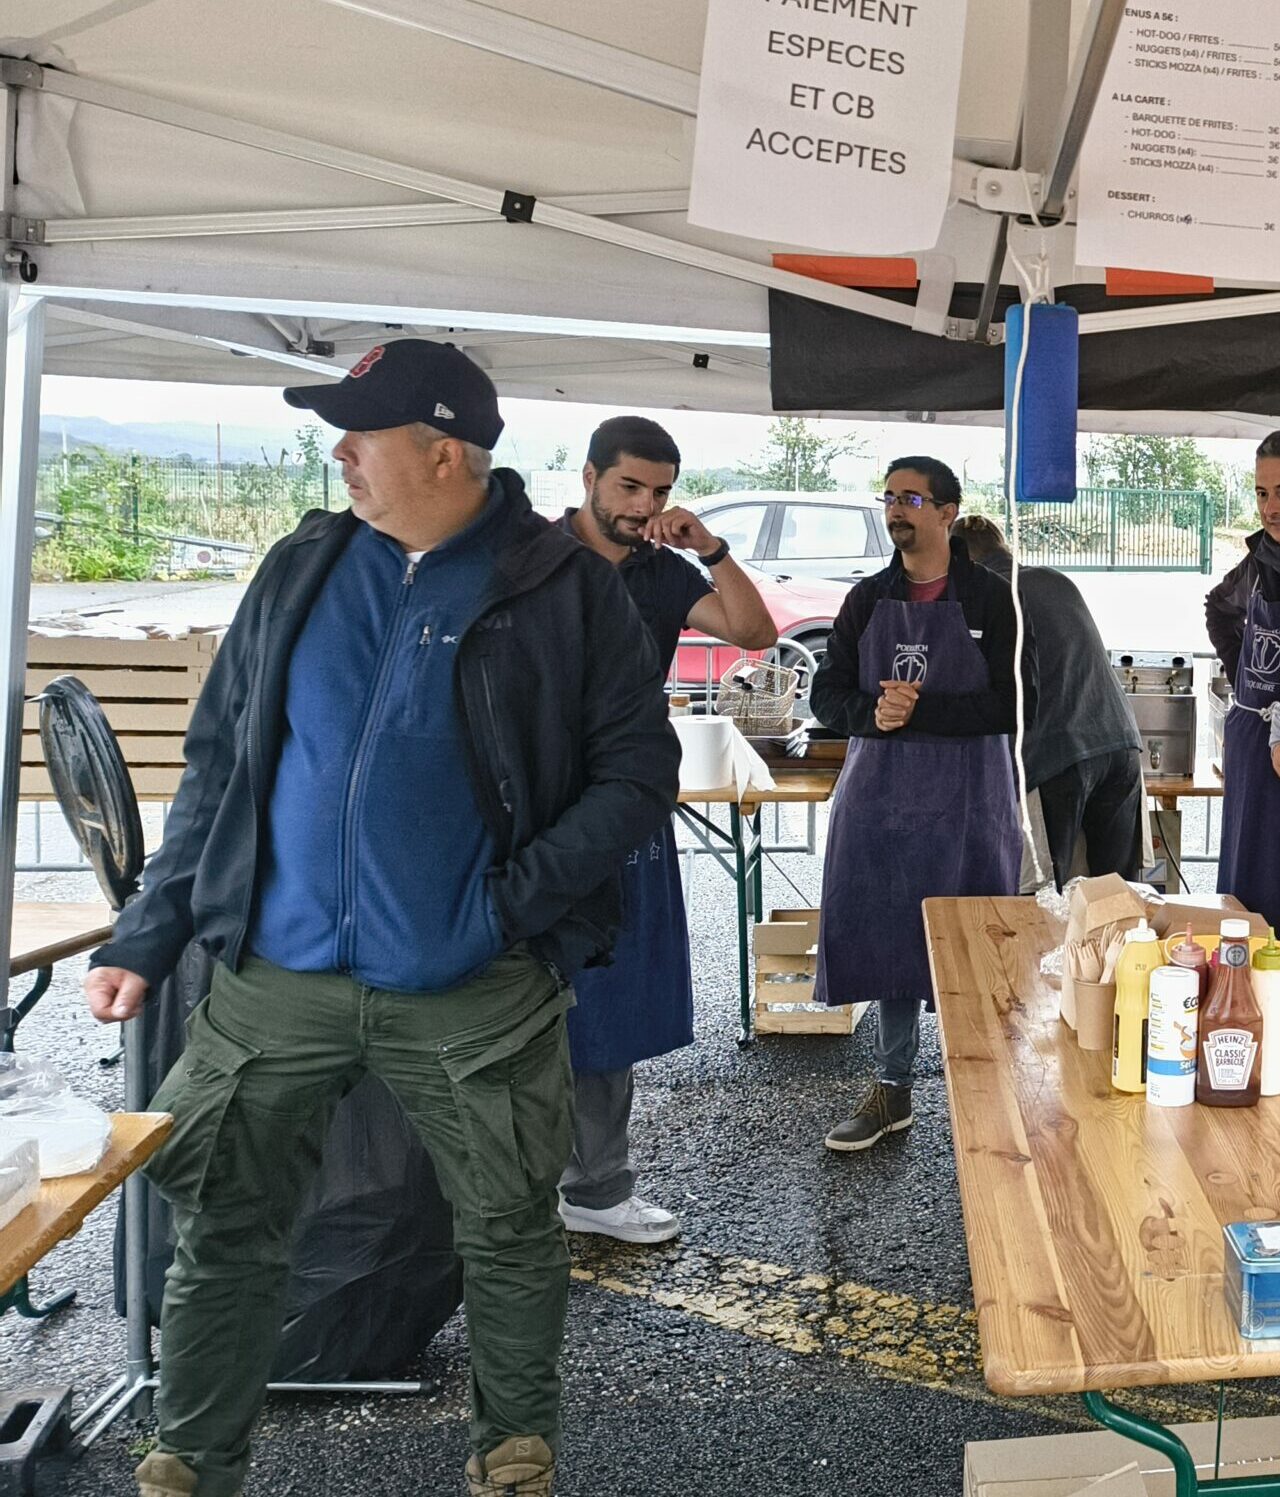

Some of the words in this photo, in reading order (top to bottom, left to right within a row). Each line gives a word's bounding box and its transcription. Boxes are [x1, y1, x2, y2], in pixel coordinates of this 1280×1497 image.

[766, 0, 918, 27] EMENT
[1125, 8, 1152, 19] ENUS
[1162, 13, 1173, 21] 5€
[1136, 29, 1180, 40] HOT-DOG
[1188, 34, 1220, 45] FRITES
[767, 30, 904, 75] ESPECES
[1136, 44, 1180, 56] NUGGETS
[1183, 49, 1199, 59] (x4)
[1206, 51, 1237, 62] FRITES
[1134, 59, 1167, 70] STICKS
[1169, 62, 1201, 73] MOZZA
[1203, 66, 1220, 76] (x4)
[1226, 68, 1257, 79] FRITES
[790, 83, 825, 110] ET
[832, 92, 874, 119] CB
[1112, 93, 1118, 101] A
[1121, 94, 1133, 102] LA
[1135, 95, 1165, 106] CARTE
[1132, 113, 1186, 126] BARQUETTE
[1189, 118, 1201, 127] DE
[1203, 119, 1233, 130] FRITES
[1268, 126, 1280, 135] 3€
[1132, 128, 1176, 140] HOT-DOG
[1269, 142, 1280, 150] 3€
[746, 128, 906, 174] ACCEPTES
[1130, 142, 1176, 154] NUGGETS
[1268, 156, 1279, 164] 3€
[1130, 157, 1162, 168] STICKS
[1164, 160, 1196, 171] MOZZA
[1198, 163, 1214, 173] (x4)
[1266, 170, 1278, 179] 3€
[1108, 190, 1150, 202] DESSERT
[1127, 210, 1174, 222] CHURROS
[1264, 223, 1275, 231] 3€
[1218, 1036, 1244, 1044] HEINZ
[1215, 1049, 1245, 1058] CLASSIC
[1216, 1058, 1244, 1067] BARBECUE
